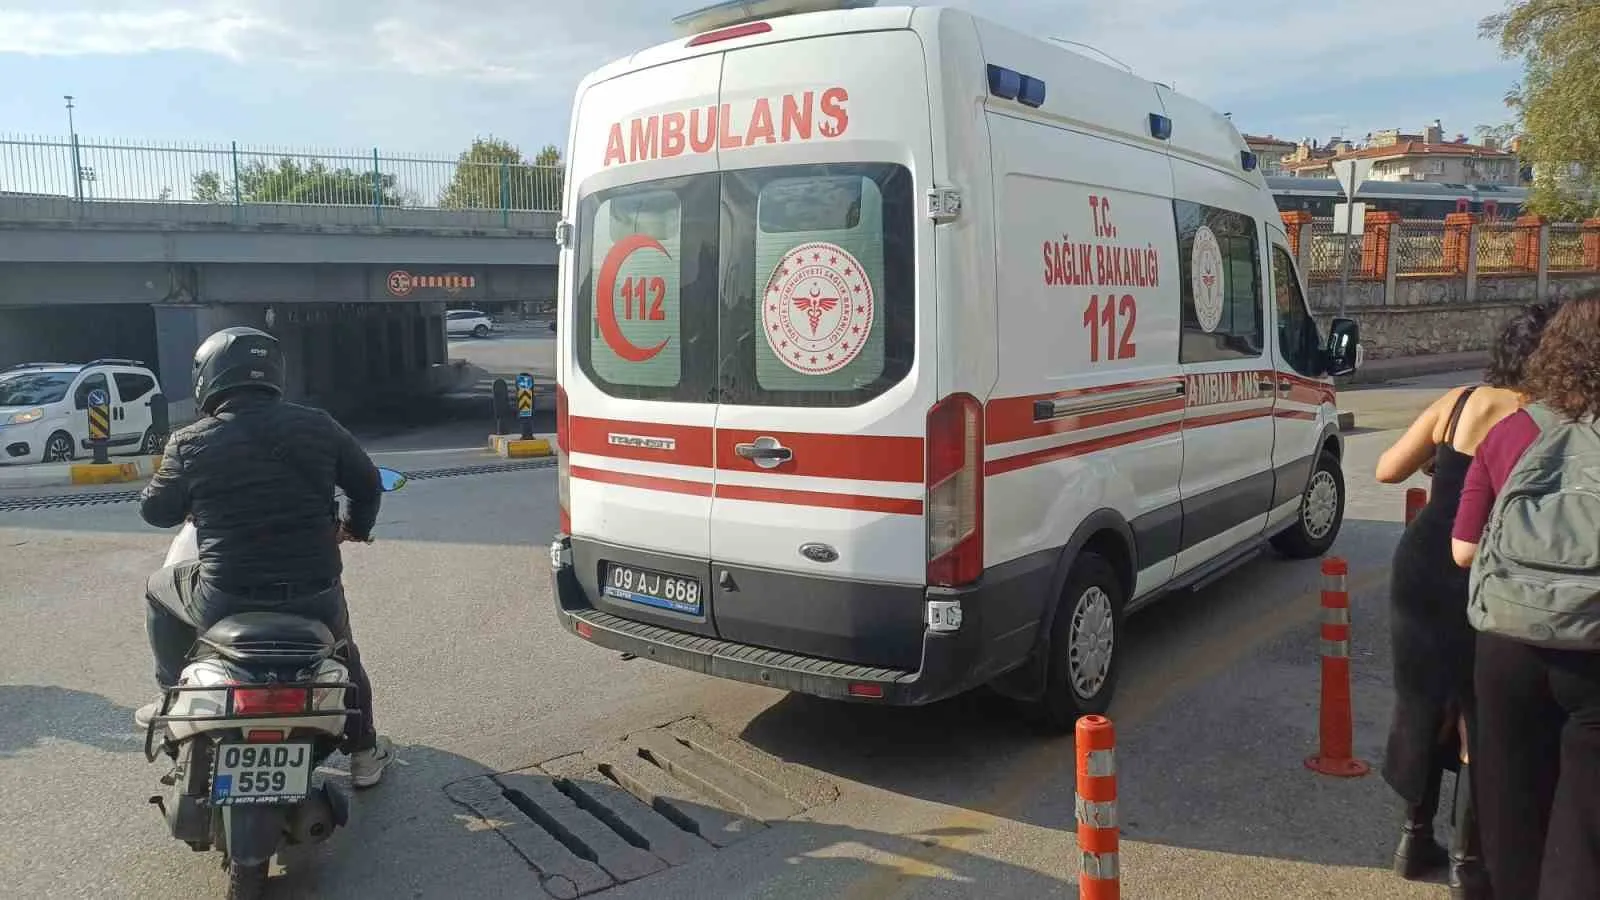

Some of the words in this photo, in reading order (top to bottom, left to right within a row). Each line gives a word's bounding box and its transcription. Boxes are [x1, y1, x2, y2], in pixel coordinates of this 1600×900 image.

[603, 87, 849, 167] AMBULANS
[1088, 195, 1117, 238] T.C.
[1043, 233, 1094, 286] SAĞLIK
[1096, 243, 1159, 287] BAKANLIĞI
[621, 276, 666, 321] 112
[1083, 294, 1137, 362] 112
[1186, 371, 1260, 407] AMBULANS
[614, 567, 633, 590] 09
[637, 572, 661, 595] AJ
[664, 578, 698, 603] 668
[225, 747, 304, 768] 09ADJ
[238, 771, 286, 792] 559
